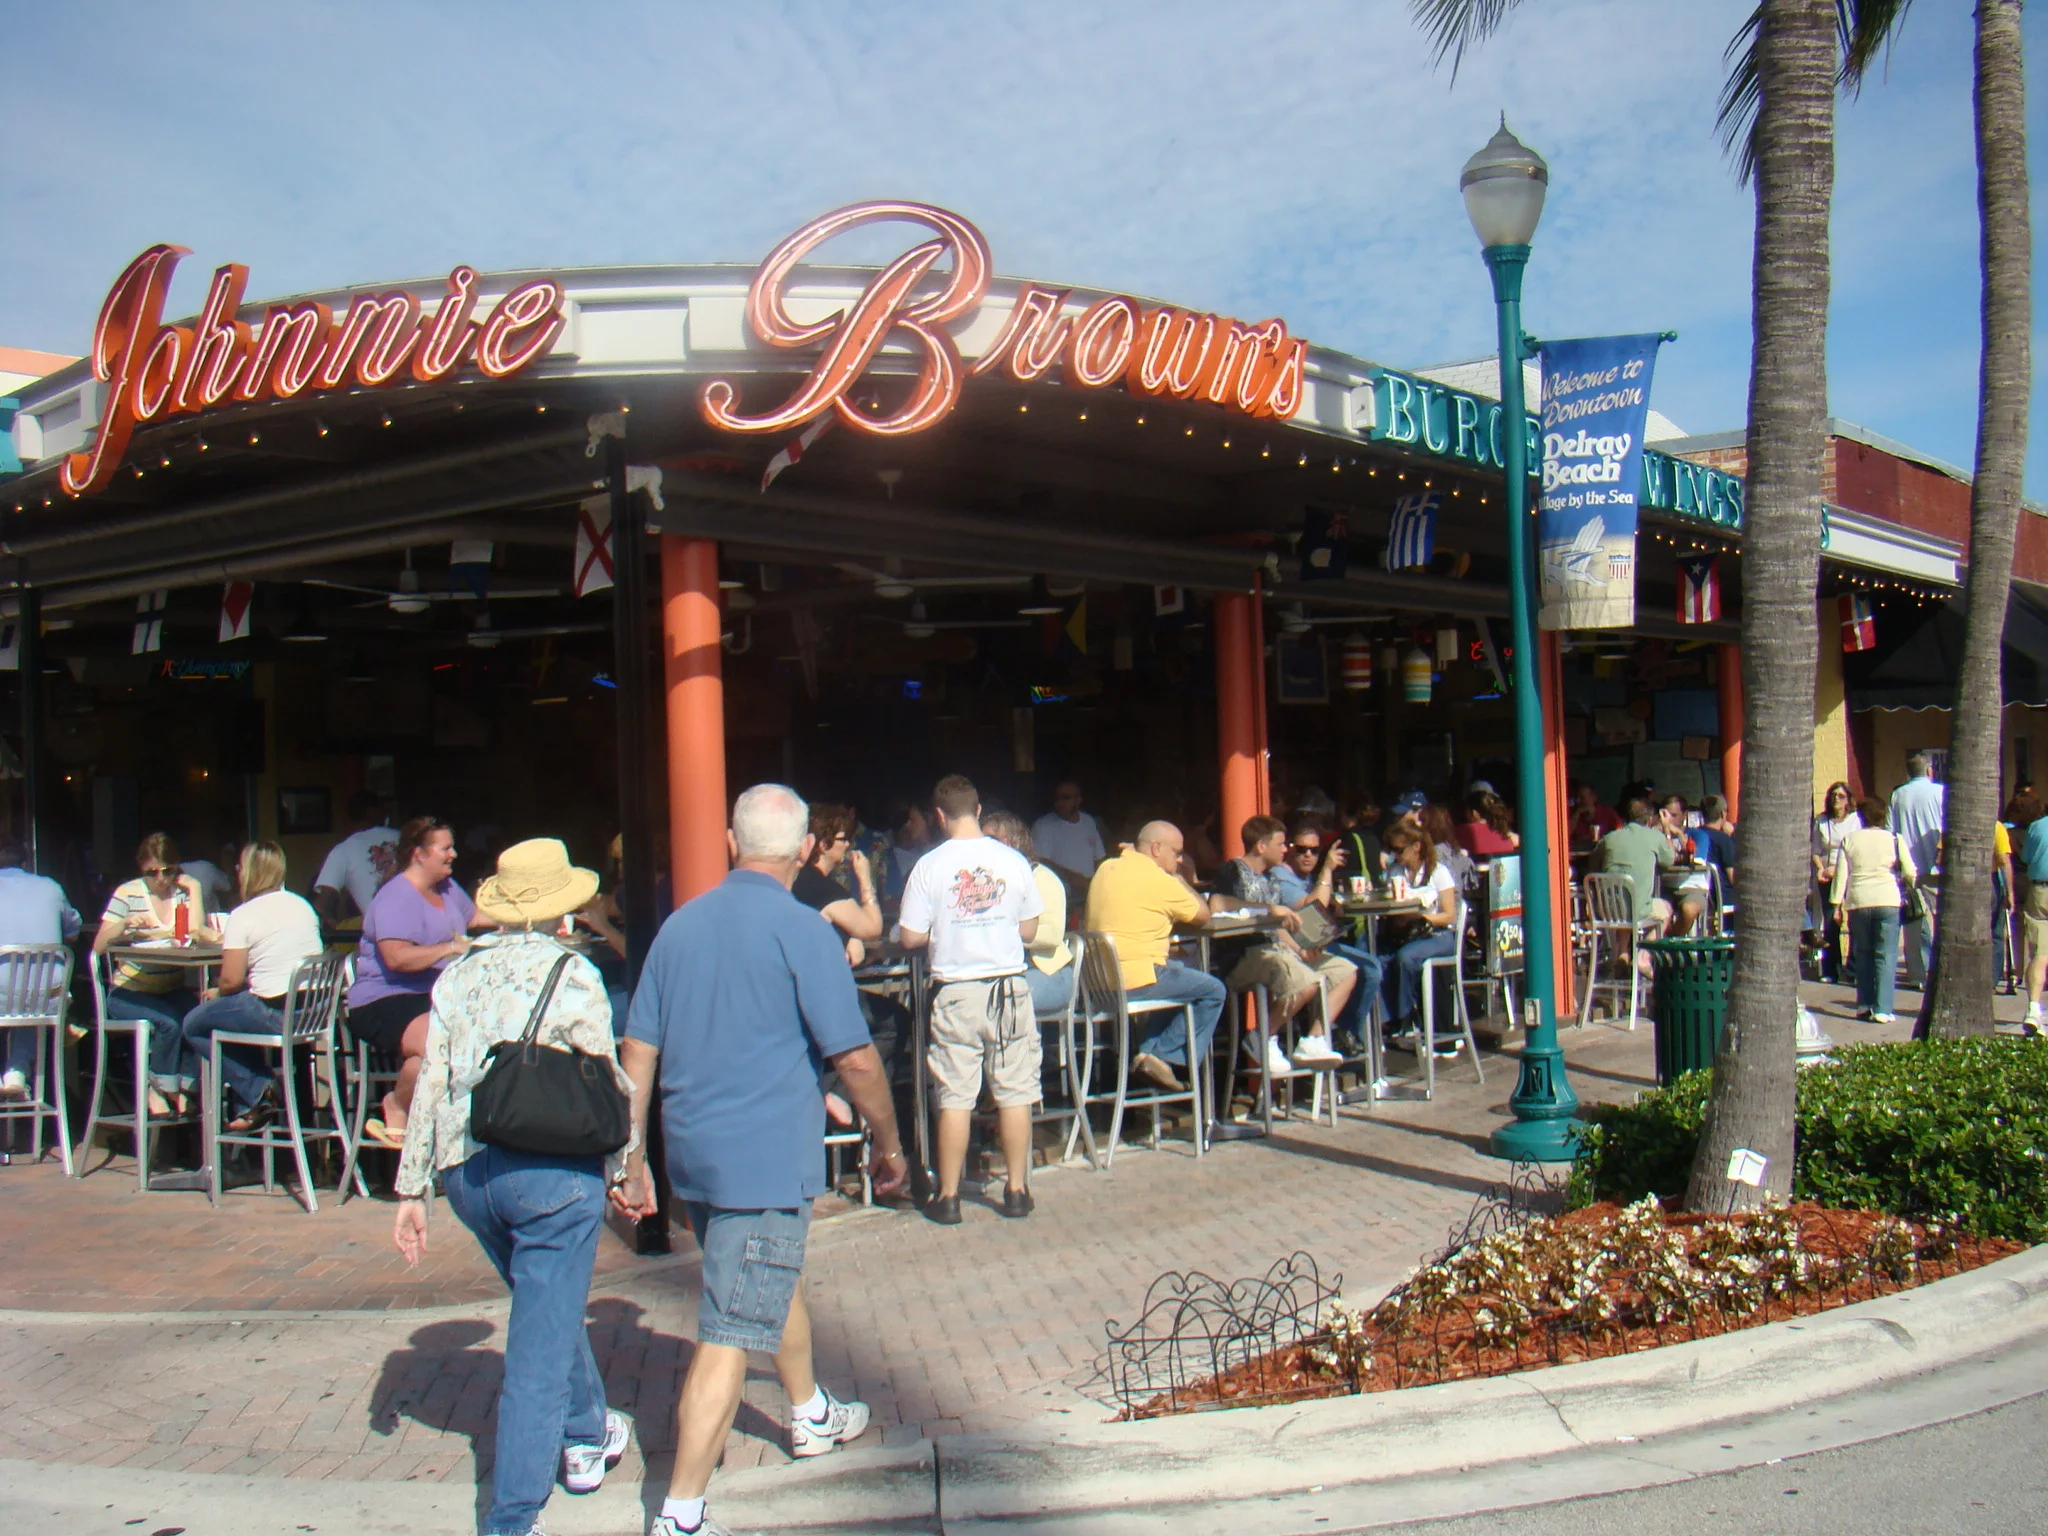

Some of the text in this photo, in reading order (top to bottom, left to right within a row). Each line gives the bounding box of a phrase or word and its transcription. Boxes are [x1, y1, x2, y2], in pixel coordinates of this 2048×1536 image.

[58, 199, 1308, 498] Johnnie Brown's
[1541, 359, 1645, 402] Welcome to
[1543, 387, 1644, 429] Downtown
[1542, 429, 1632, 462] Delray
[1541, 456, 1621, 493] Beach
[1641, 452, 1745, 528] WINGS
[1538, 489, 1634, 512] llage by the Sea
